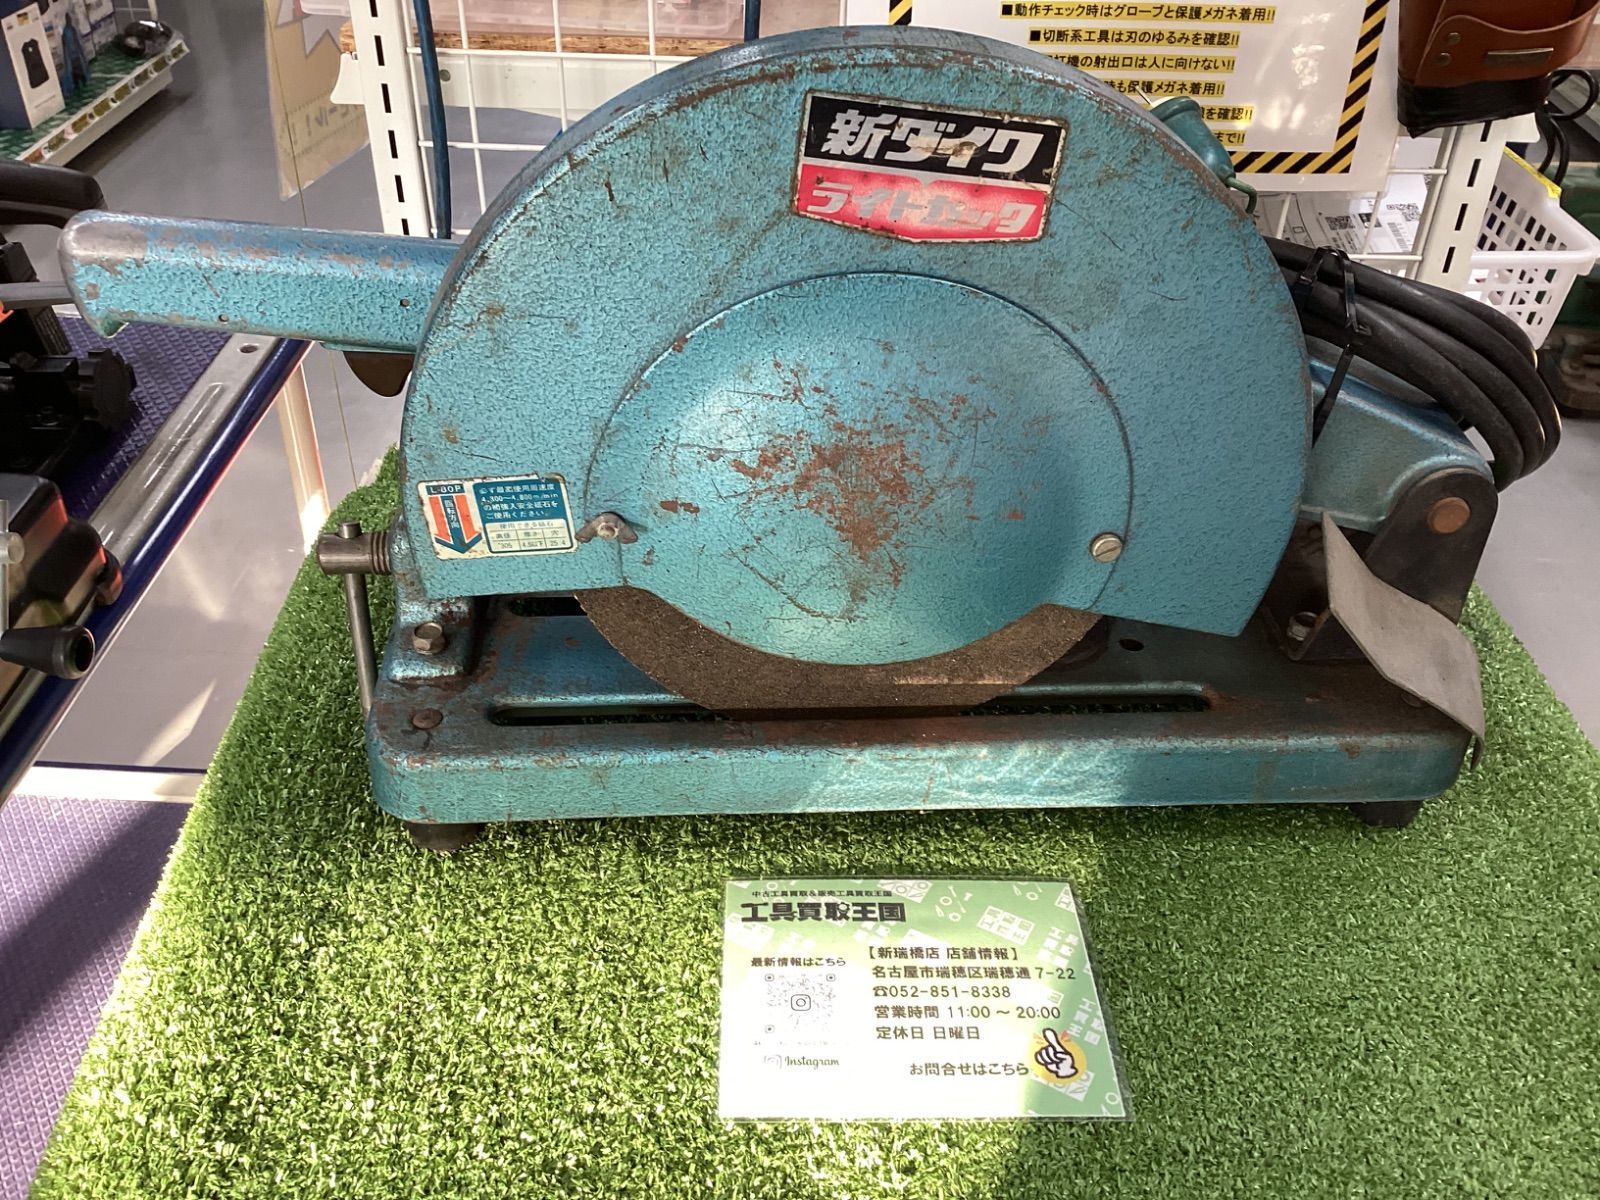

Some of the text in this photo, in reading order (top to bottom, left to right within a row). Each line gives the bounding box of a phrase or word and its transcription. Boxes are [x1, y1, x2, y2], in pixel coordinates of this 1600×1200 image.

[1014, 4, 1275, 21] 動作チェック時はグローブと保護メガネ着用!!
[1042, 29, 1240, 46] 切断系工具は刃のゆるみを確認!!
[1048, 54, 1236, 71] 機の射出口は人に向けない!!
[1200, 106, 1253, 120] を確認!!
[741, 902, 906, 922] 工具買取王国
[751, 957, 846, 967] 最新情報はこちら
[1035, 967, 1076, 980] 7-22
[874, 1005, 939, 1019] 営業時間
[947, 1006, 991, 1019] 11:00
[1016, 1006, 1061, 1019] 20:00
[876, 1026, 980, 1040] 定休日 日曜日
[785, 1056, 840, 1070] Instagram
[909, 1062, 1030, 1077] お問合せはこちら
